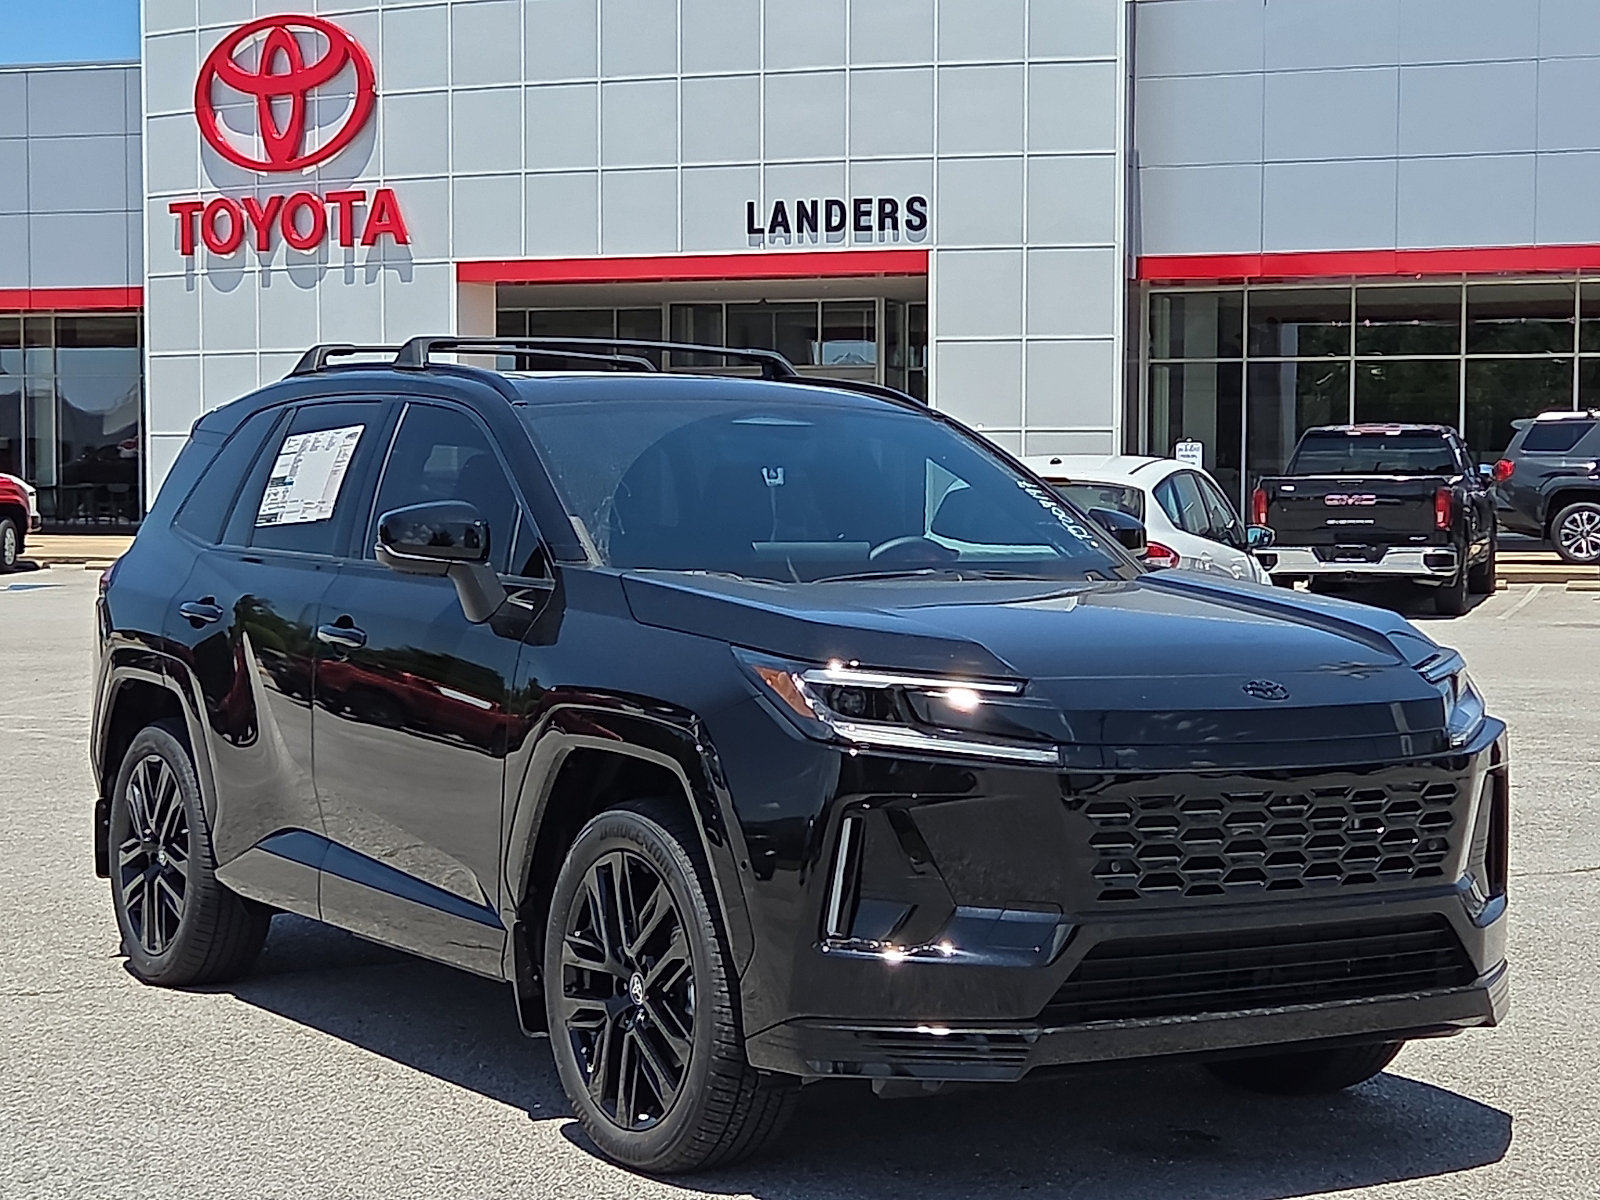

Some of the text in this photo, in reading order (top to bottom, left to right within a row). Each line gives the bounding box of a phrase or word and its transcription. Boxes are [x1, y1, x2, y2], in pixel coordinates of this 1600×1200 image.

[169, 188, 411, 256] TOYOTA
[747, 196, 928, 235] LANDERS
[1325, 494, 1376, 506] GMC
